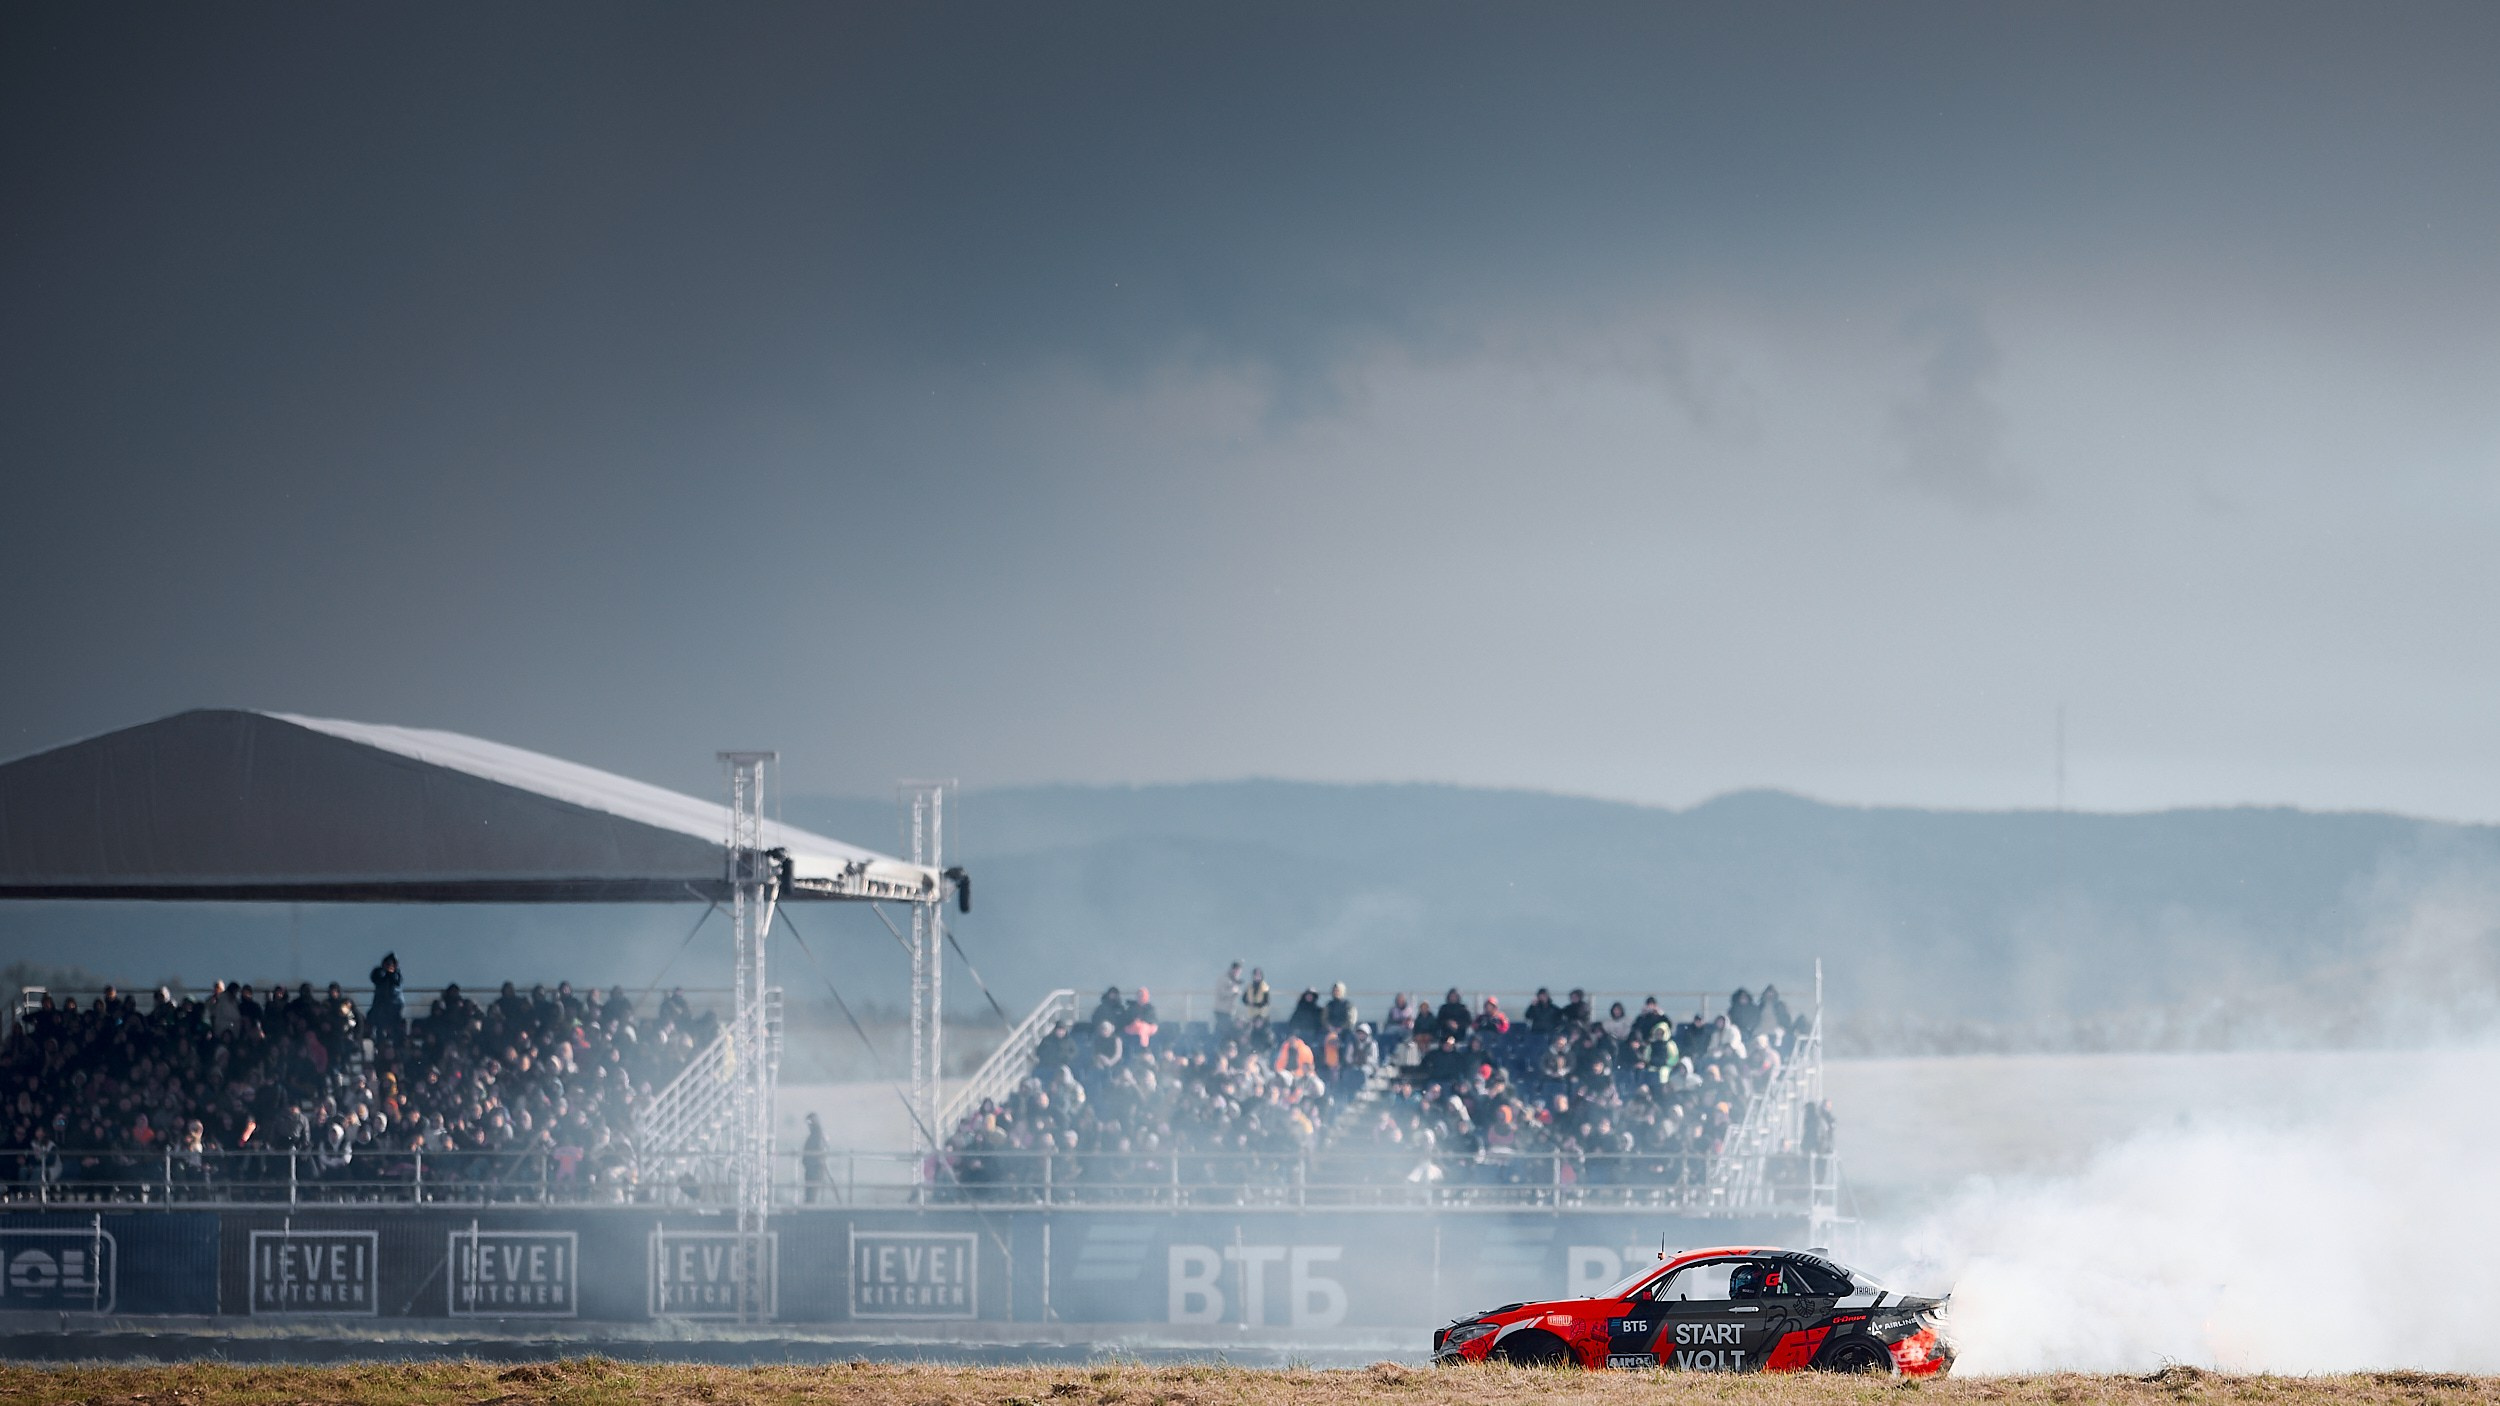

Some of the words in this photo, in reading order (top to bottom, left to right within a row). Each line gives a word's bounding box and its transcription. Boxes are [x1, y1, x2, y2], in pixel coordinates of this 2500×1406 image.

[0, 1248, 103, 1299] OL
[263, 1283, 365, 1303] KITCHEN
[462, 1284, 565, 1304] KITCHEN
[862, 1286, 965, 1305] KITCHEN
[1169, 1244, 1349, 1328] ВТБ
[1623, 1320, 1648, 1332] ВТБ
[1675, 1323, 1745, 1345] START
